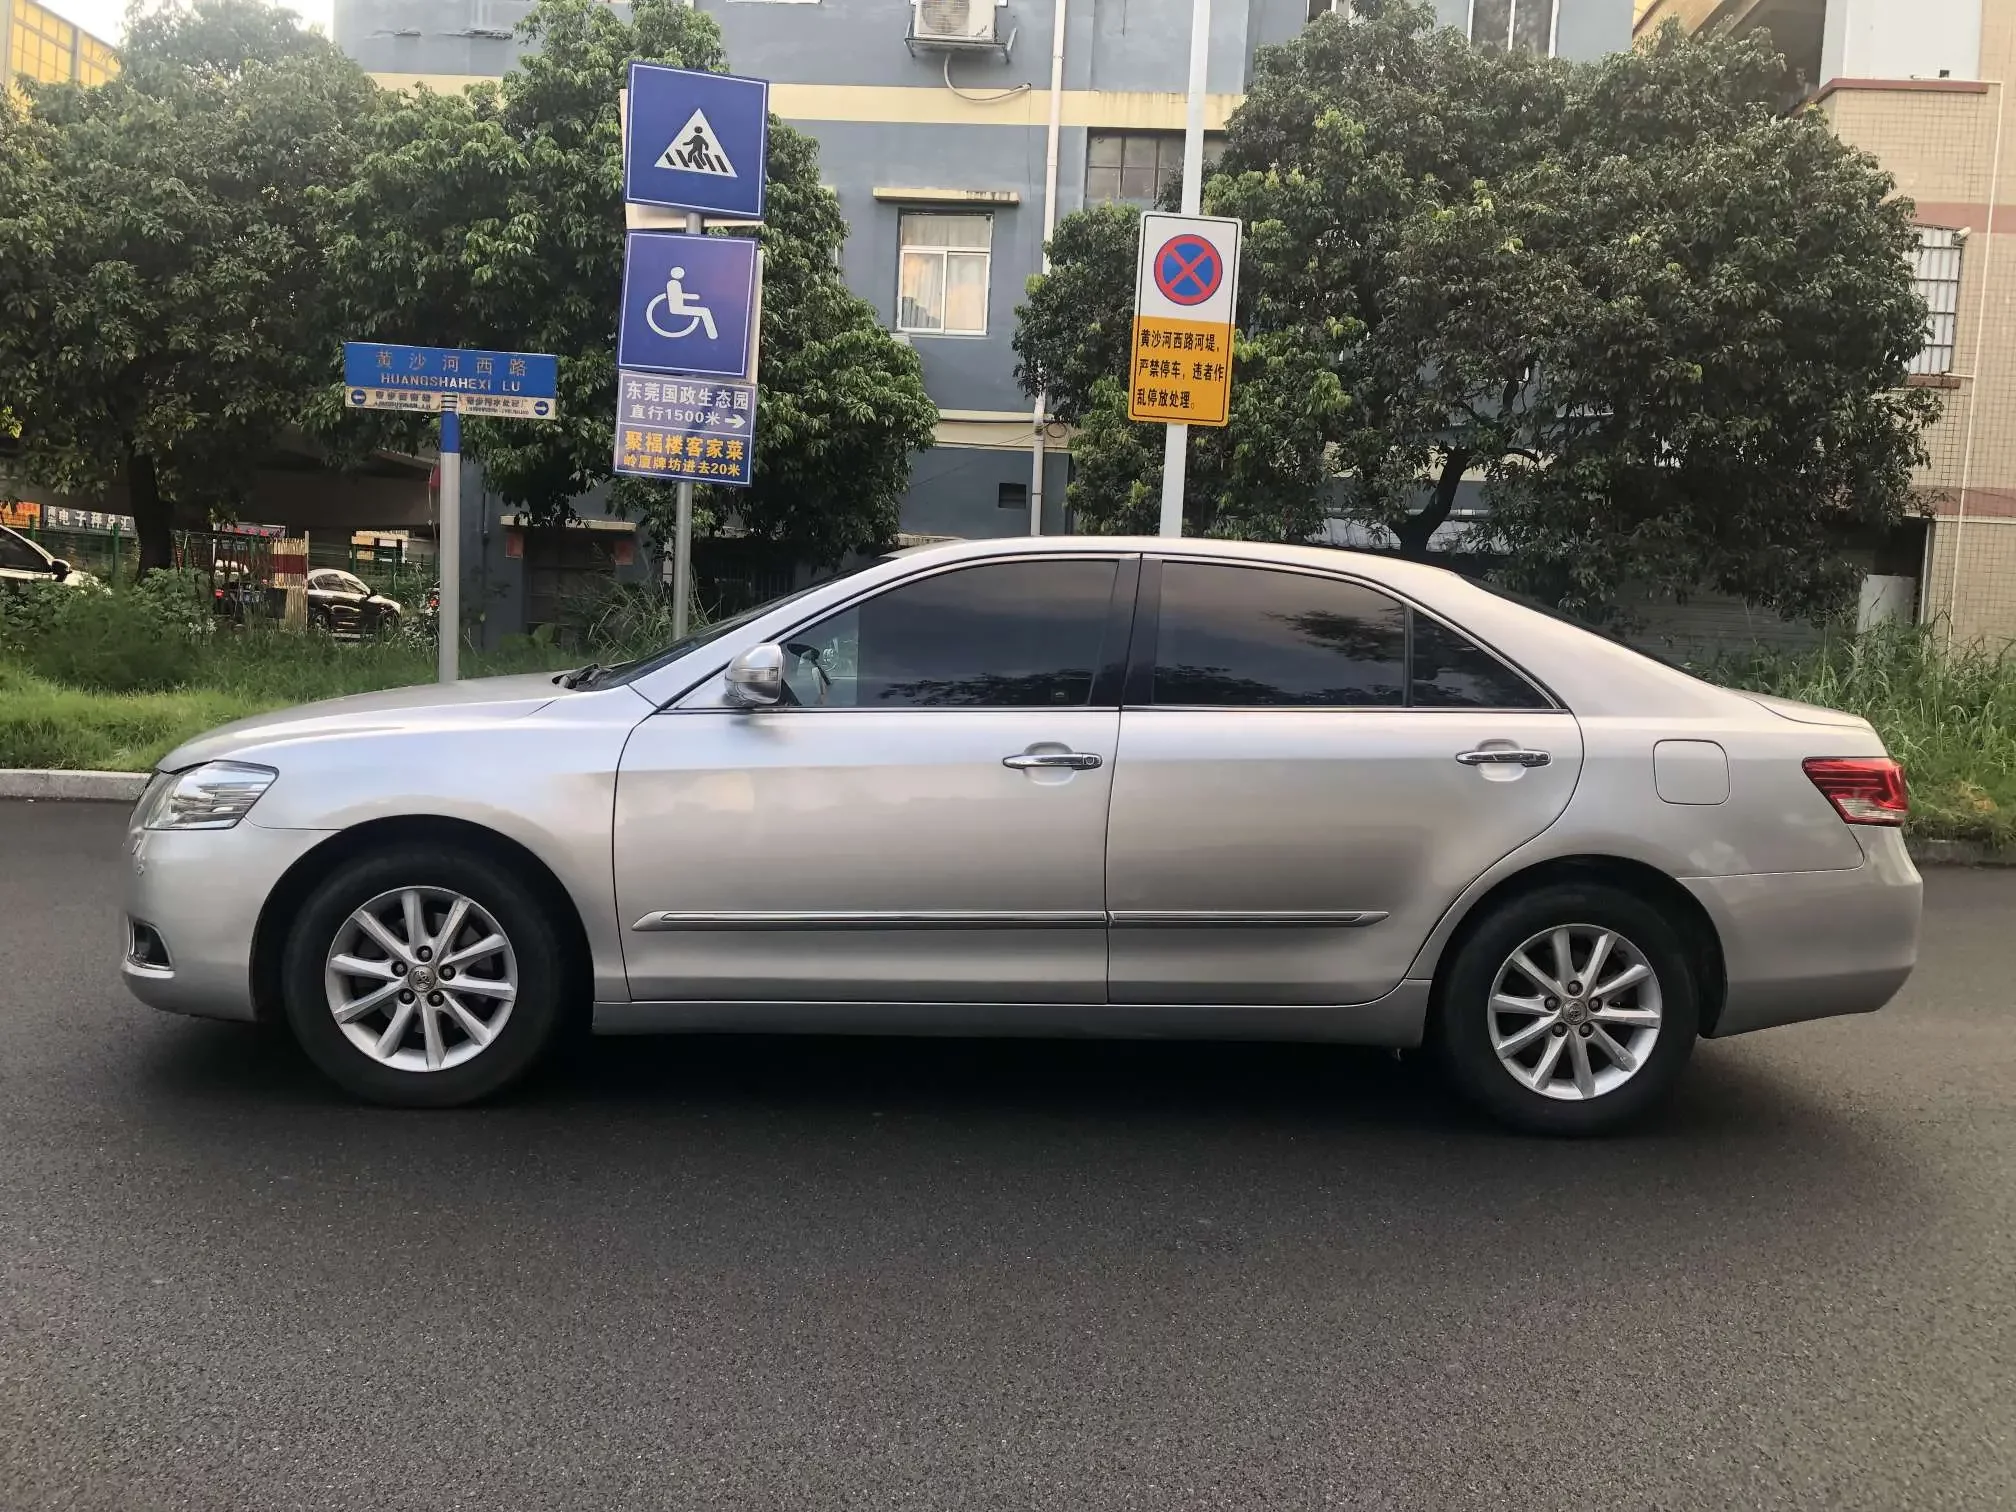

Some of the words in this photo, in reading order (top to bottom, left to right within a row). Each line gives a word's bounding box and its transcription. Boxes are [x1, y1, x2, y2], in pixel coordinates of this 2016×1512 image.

[376, 350, 528, 377] 黄沙河西路
[381, 373, 491, 390] HUANGSHAHEXI
[502, 381, 521, 392] LU
[626, 381, 748, 410] 东莞国政生态园
[629, 404, 721, 426] 直行1500米
[624, 431, 744, 461] 聚福楼客家菜
